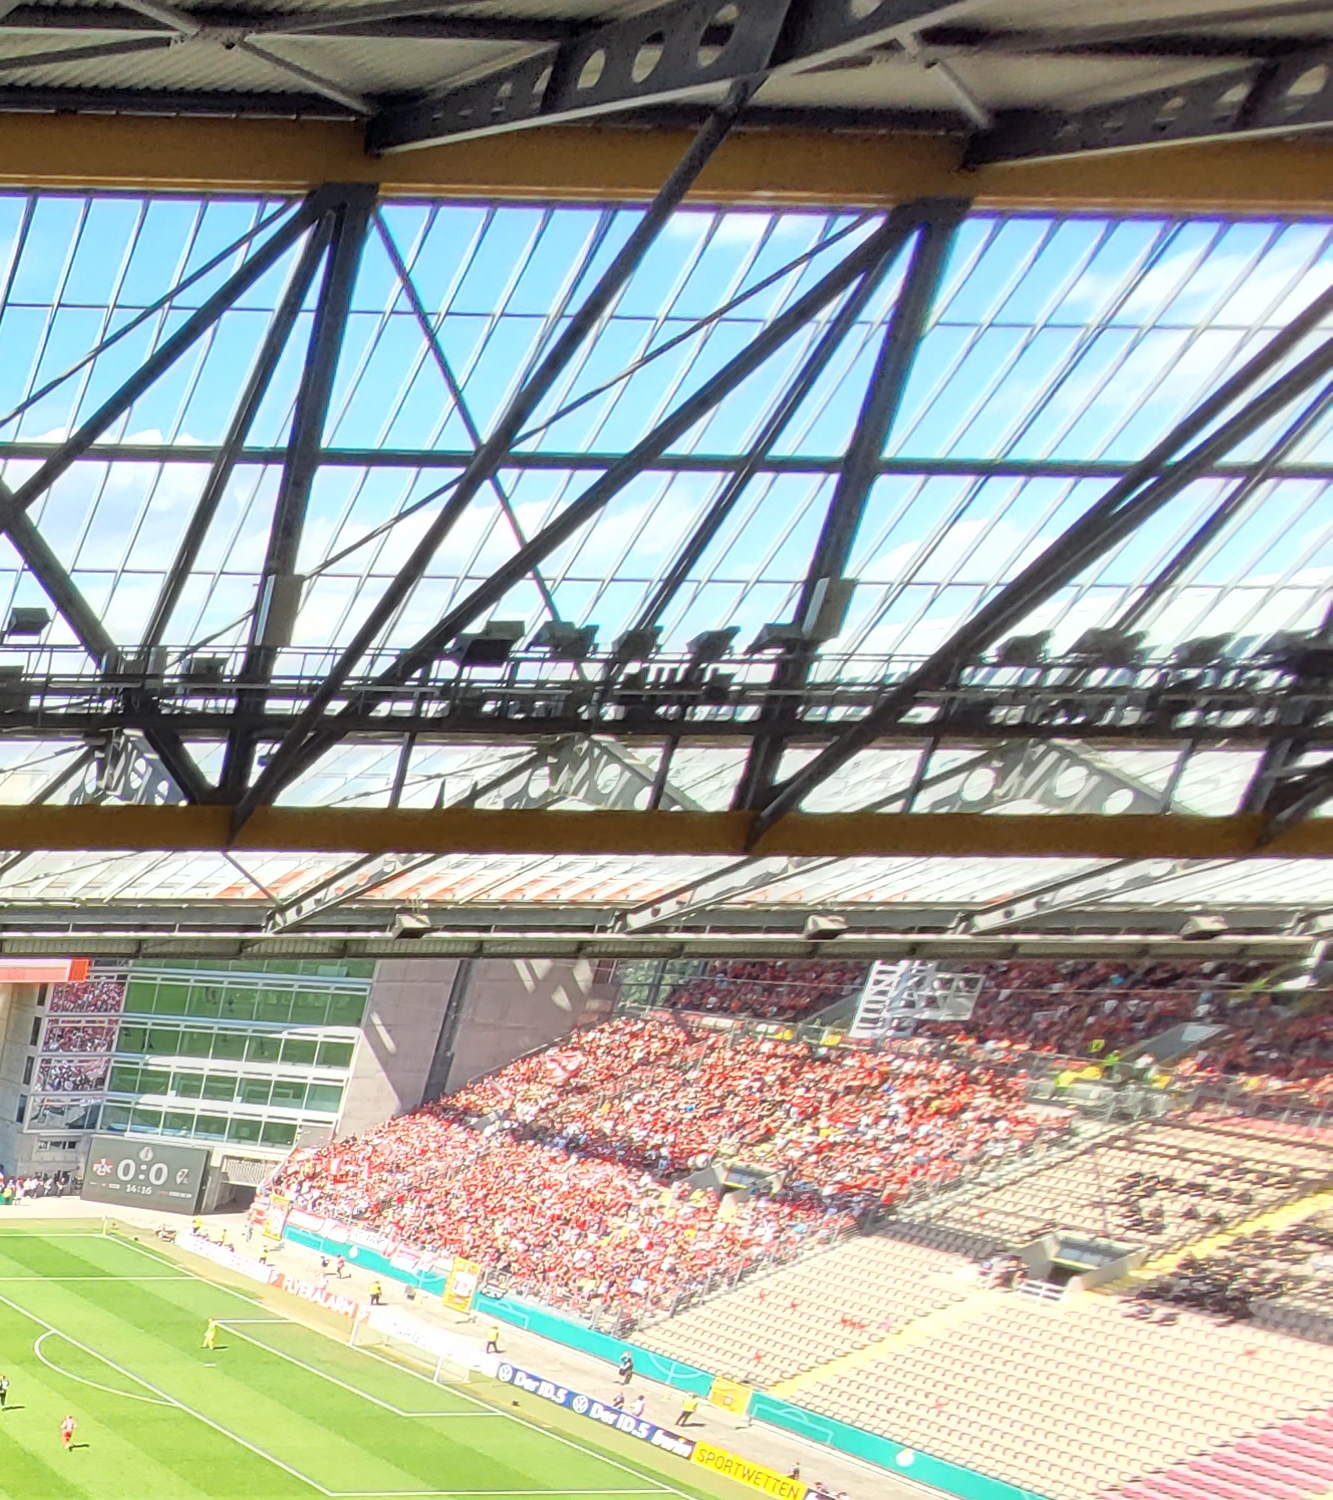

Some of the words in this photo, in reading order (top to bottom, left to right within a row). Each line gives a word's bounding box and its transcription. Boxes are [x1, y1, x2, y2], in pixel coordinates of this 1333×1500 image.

[117, 1159, 168, 1186] 0:0
[125, 1184, 152, 1195] 14:16
[513, 1370, 539, 1395] Der
[537, 1377, 568, 1405] ID.5
[590, 1402, 617, 1427] Der
[615, 1410, 651, 1440] ID.5
[651, 1429, 694, 1459] bwin
